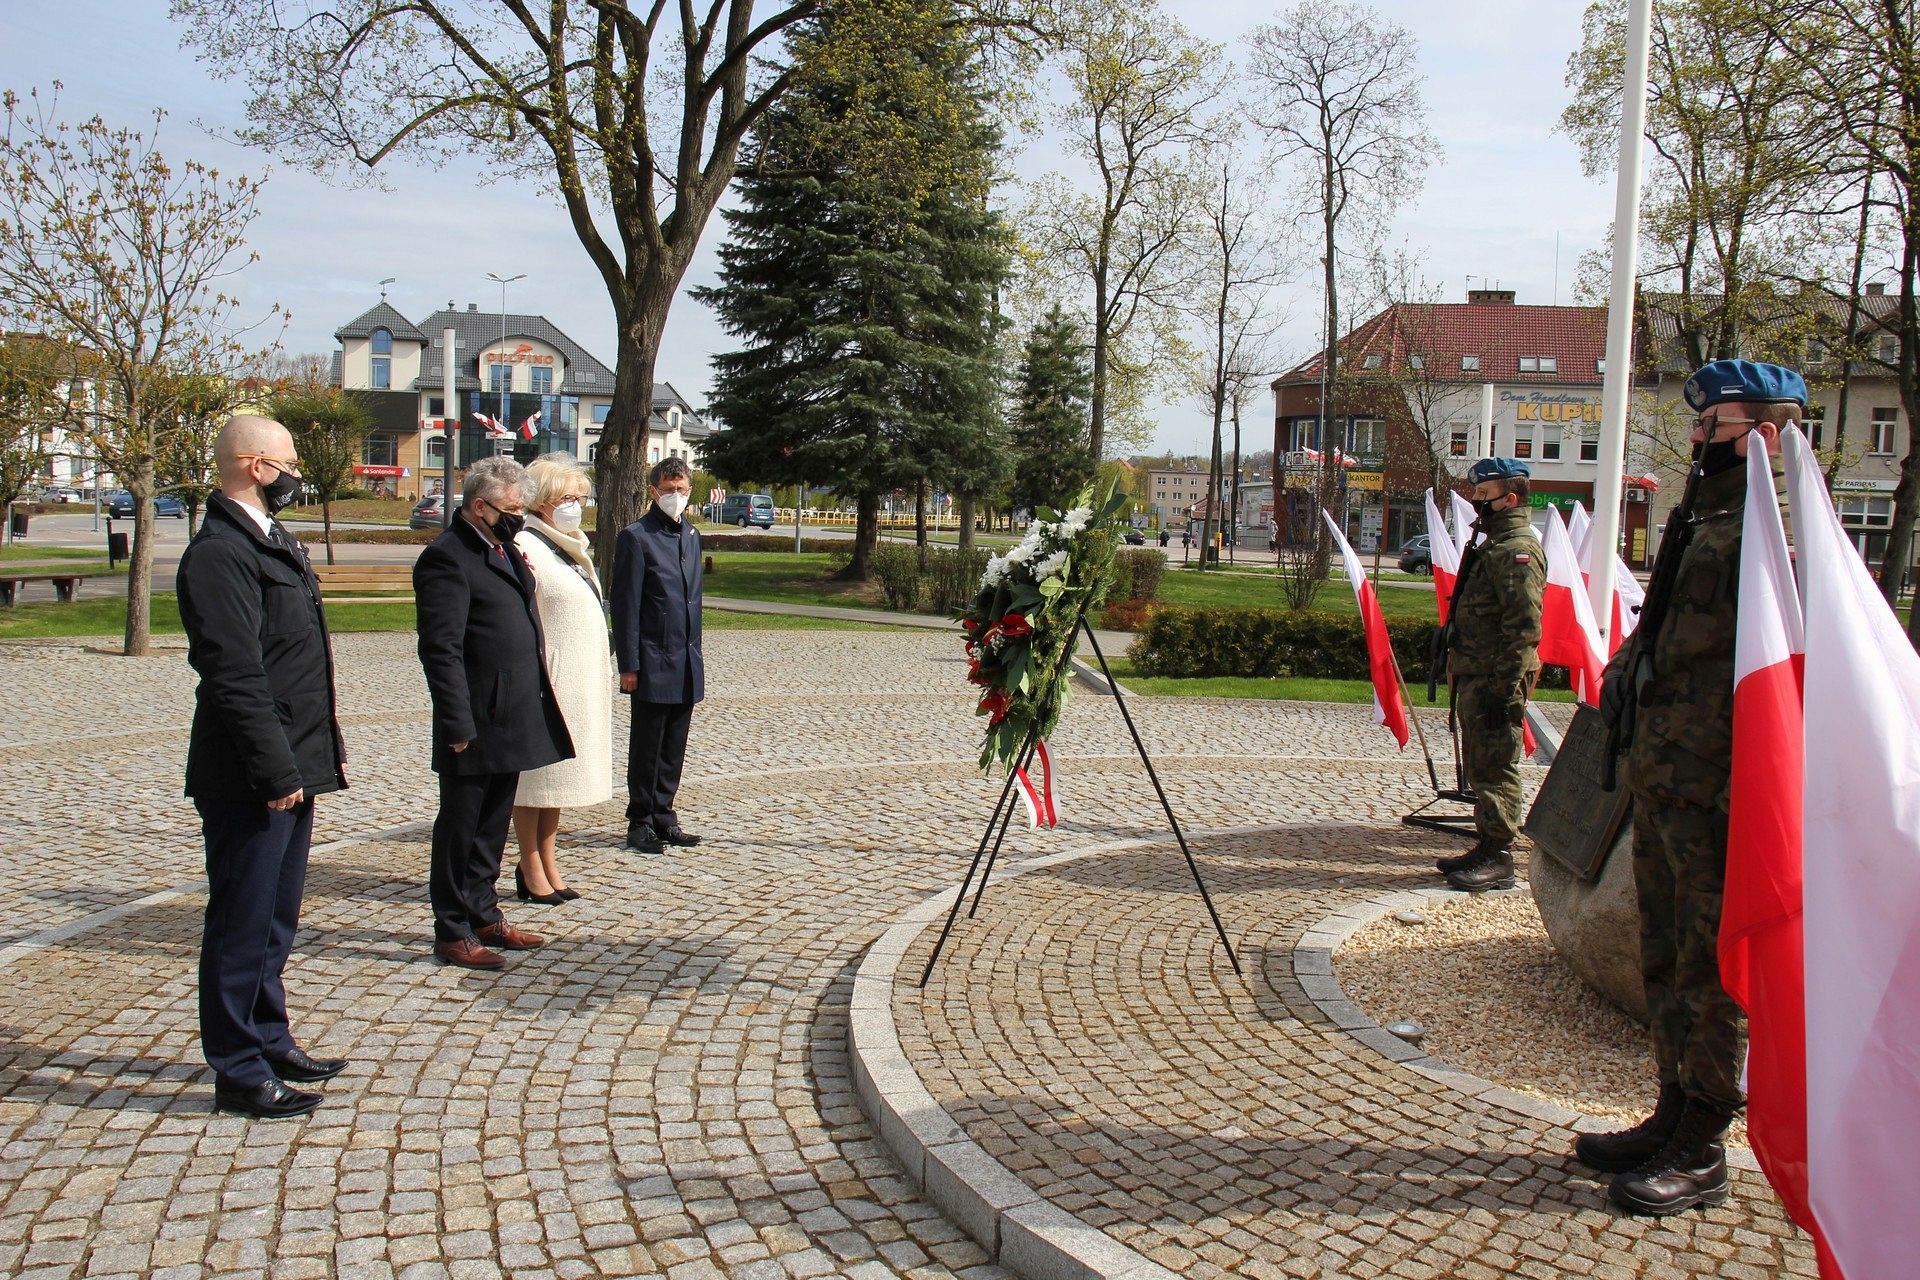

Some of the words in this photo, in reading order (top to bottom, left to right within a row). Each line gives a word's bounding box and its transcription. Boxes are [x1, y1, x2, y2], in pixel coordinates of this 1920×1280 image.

[487, 352, 554, 364] DELFINO
[1500, 391, 1526, 401] Dom
[1530, 391, 1587, 404] Handlowy
[1527, 494, 1560, 505] abka
